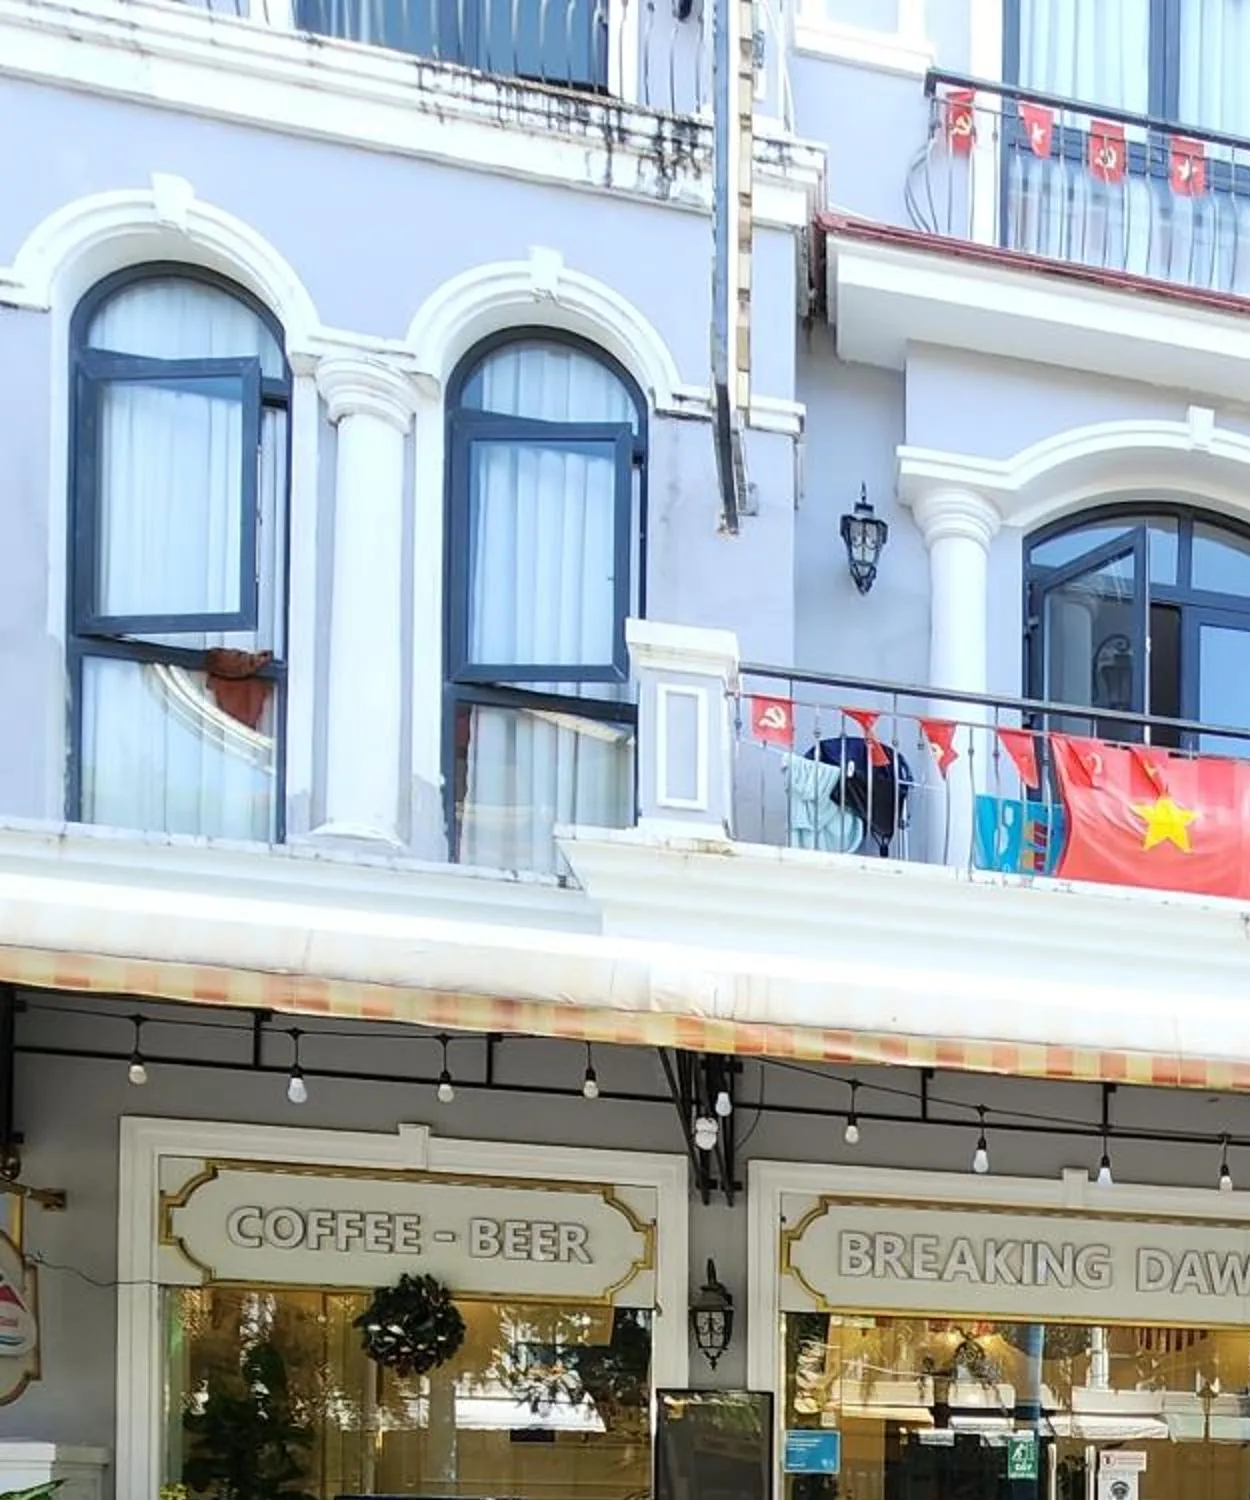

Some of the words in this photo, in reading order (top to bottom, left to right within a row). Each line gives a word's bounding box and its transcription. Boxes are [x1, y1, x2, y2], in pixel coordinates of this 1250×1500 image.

[226, 1205, 421, 1255] COFFEE
[469, 1217, 593, 1264] BEER
[838, 1230, 1113, 1289] BREAKING
